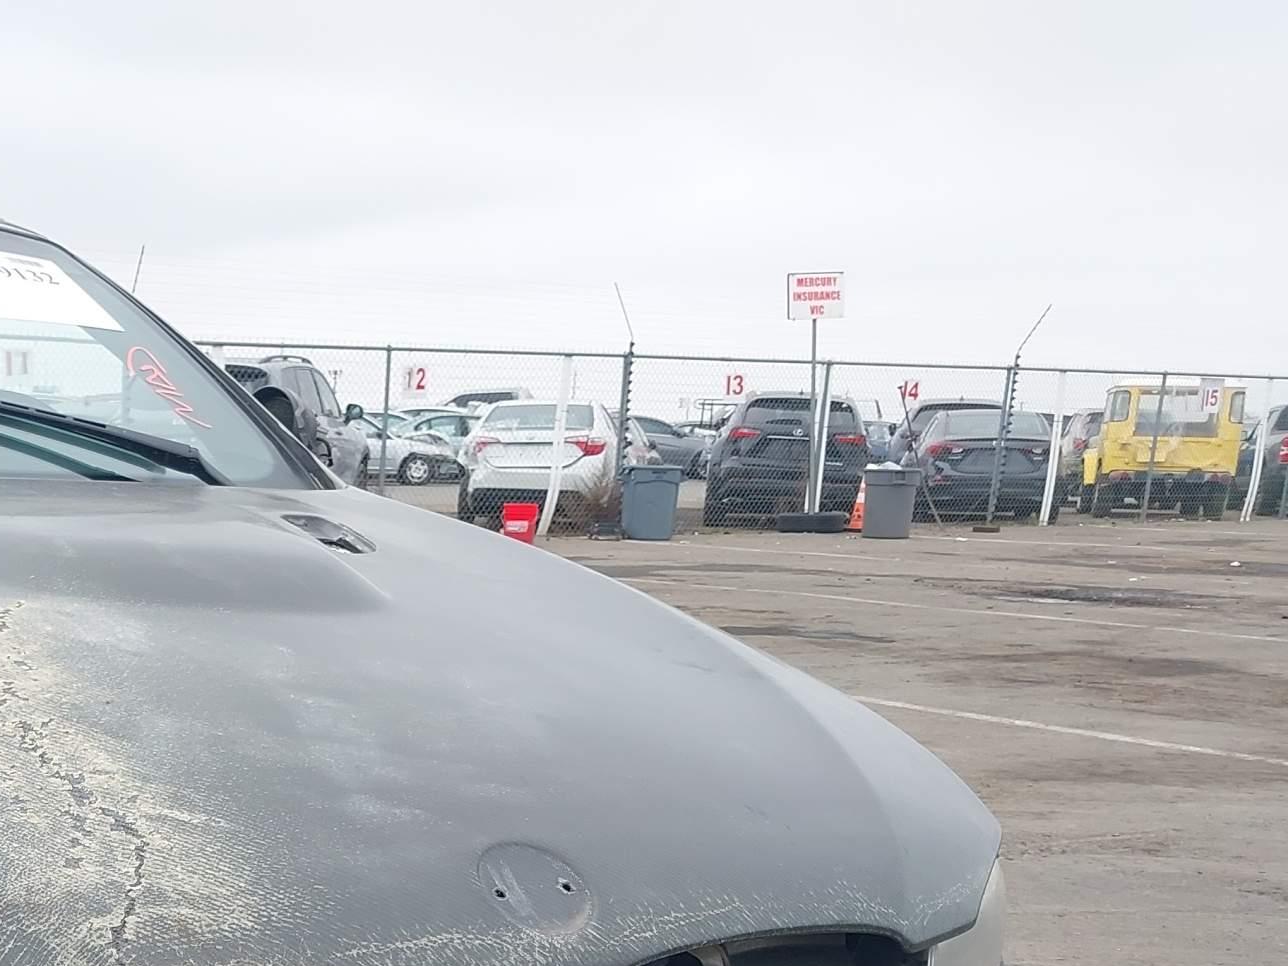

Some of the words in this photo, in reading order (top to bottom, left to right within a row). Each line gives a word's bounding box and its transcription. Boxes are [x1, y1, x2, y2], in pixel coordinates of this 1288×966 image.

[796, 276, 838, 287] MERCURY
[793, 290, 841, 302] INSURANCE
[809, 304, 825, 315] VIC
[407, 367, 426, 390] 12
[726, 375, 745, 396] 13
[902, 380, 920, 401] 14
[1204, 388, 1220, 407] 15
